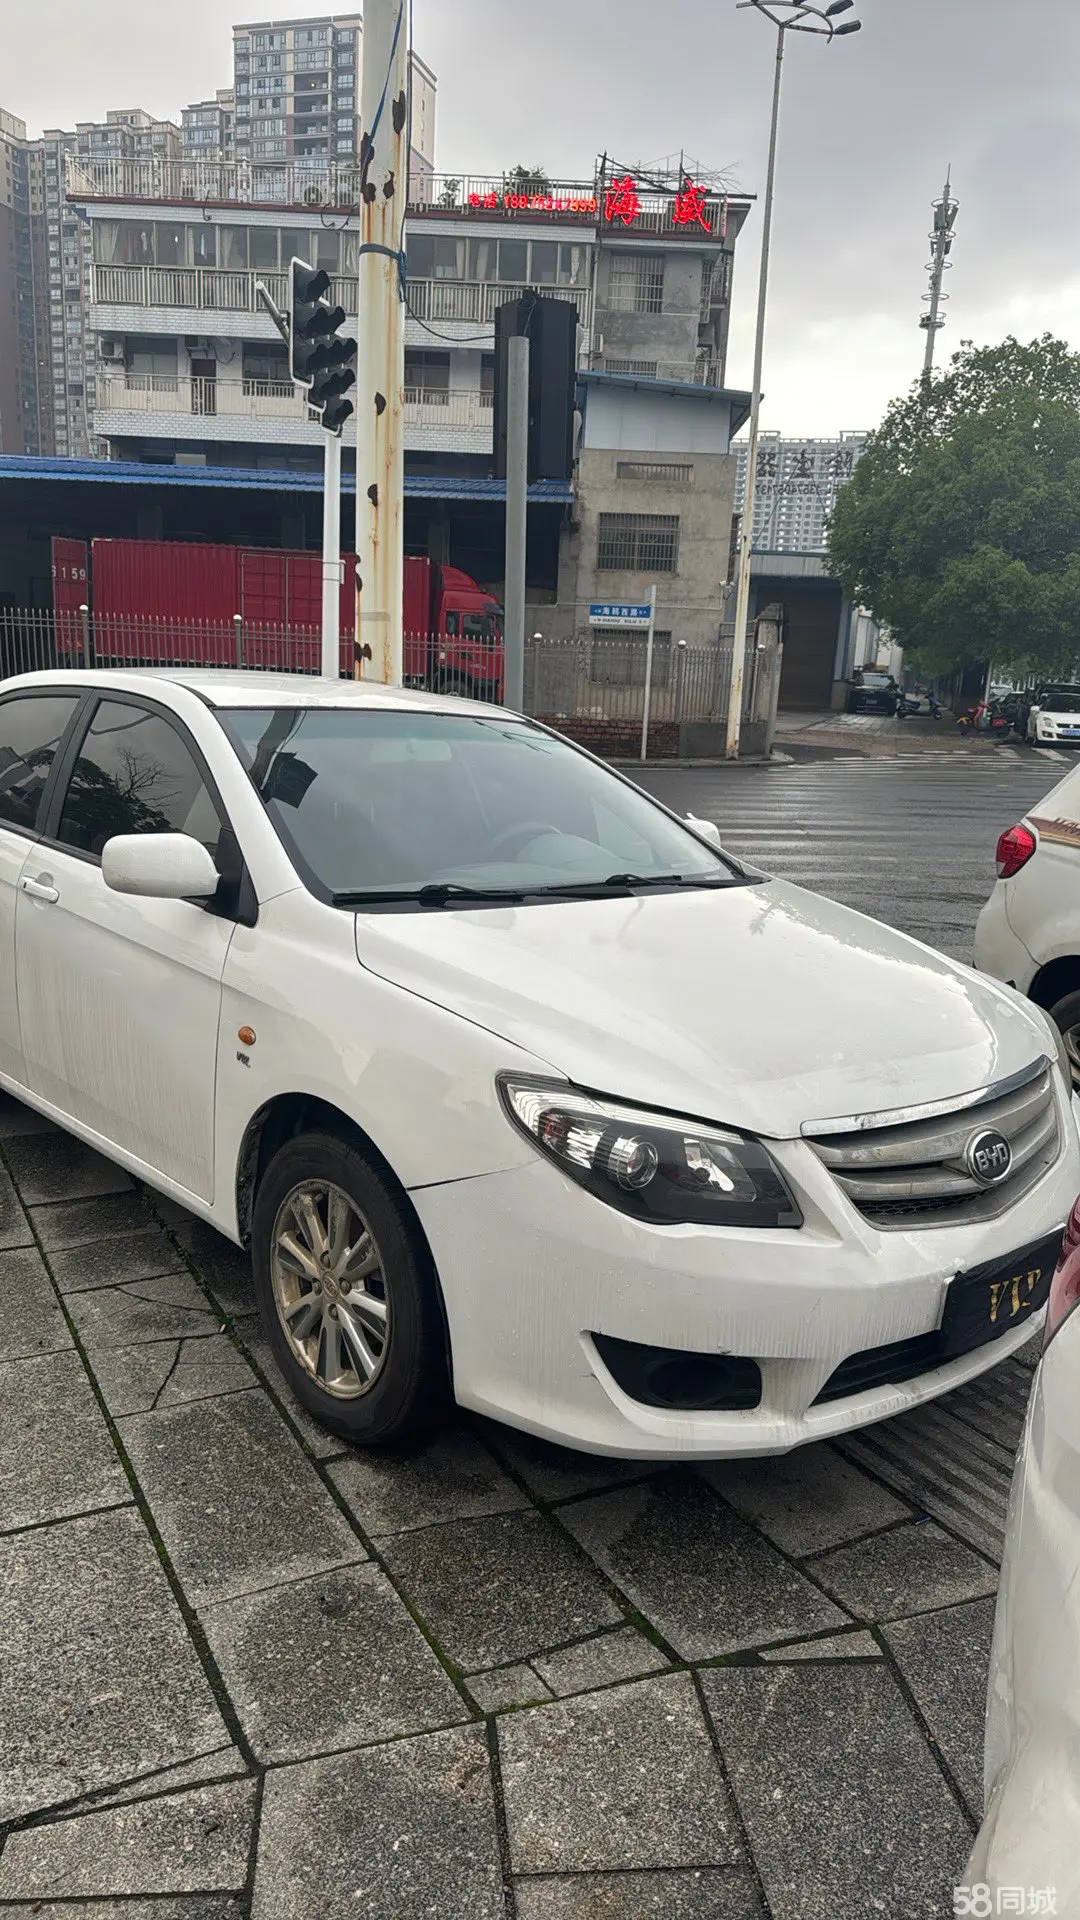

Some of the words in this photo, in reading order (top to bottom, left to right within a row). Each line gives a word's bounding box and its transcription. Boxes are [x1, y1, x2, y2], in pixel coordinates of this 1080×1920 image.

[469, 192, 497, 208] 电话
[975, 1142, 1008, 1172] BYD
[989, 1268, 1042, 1323] VIP
